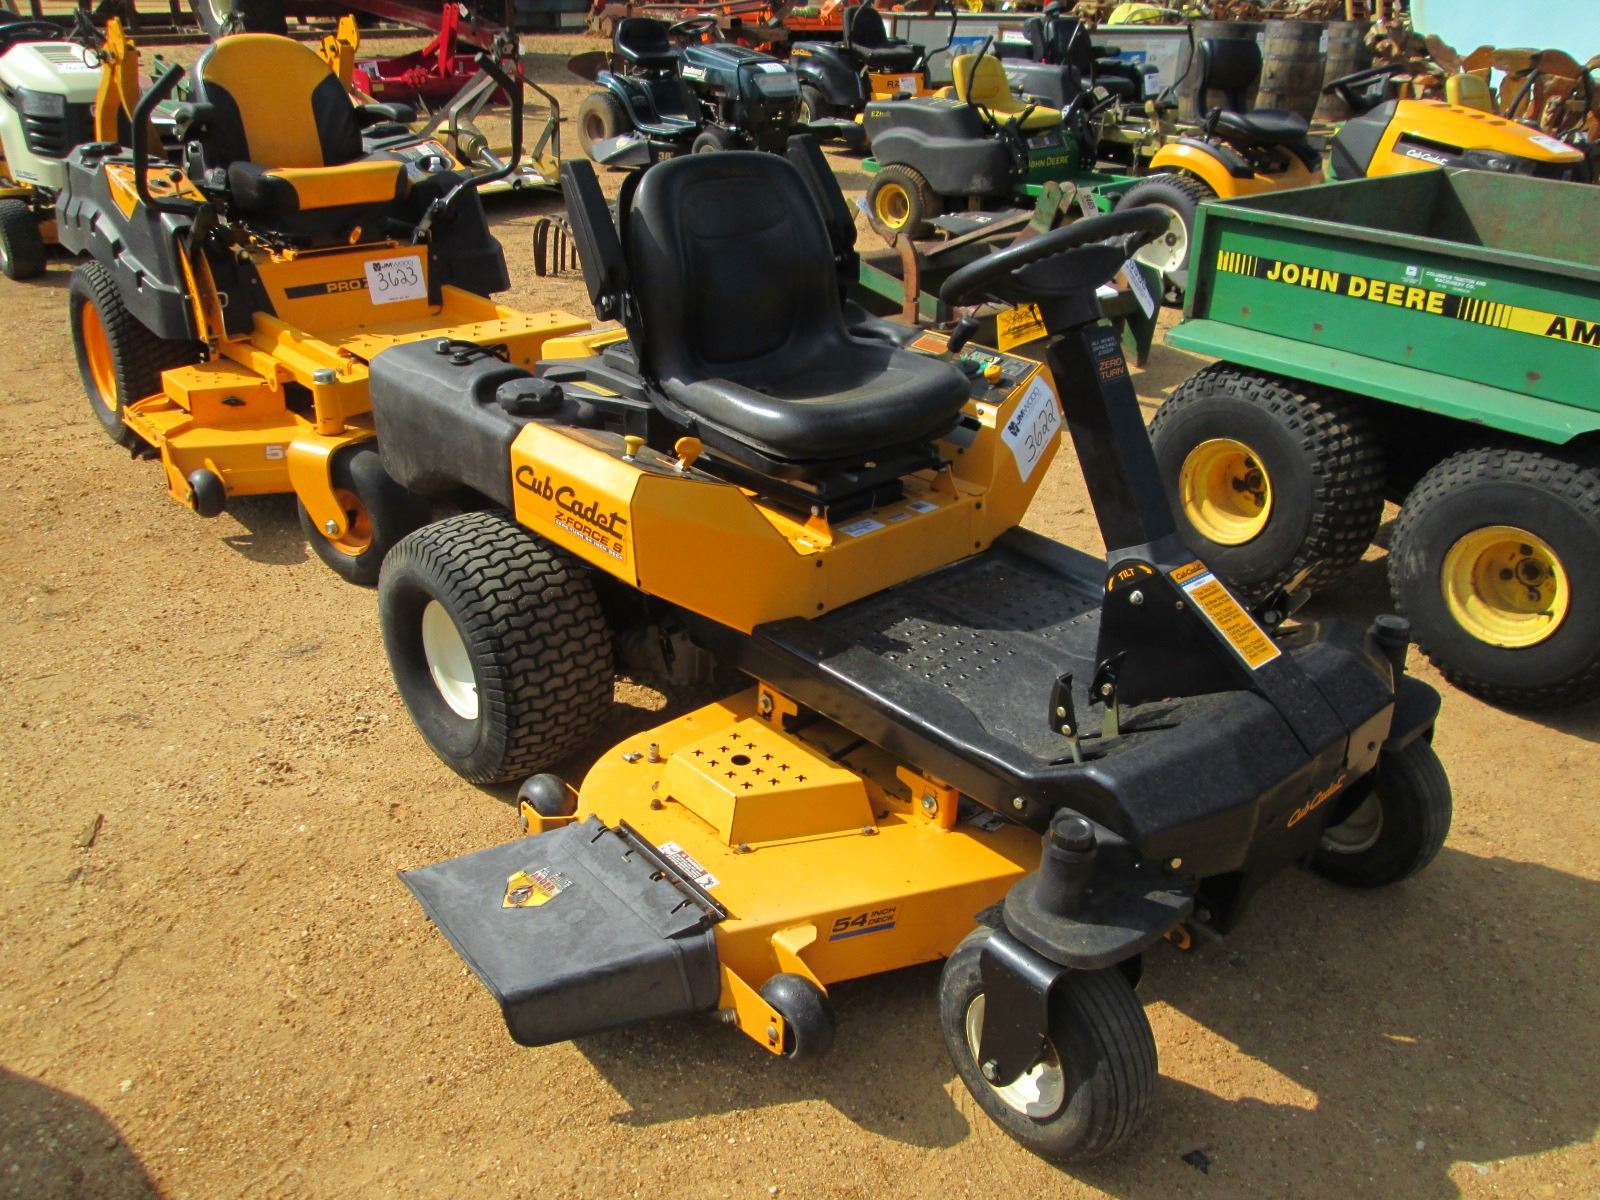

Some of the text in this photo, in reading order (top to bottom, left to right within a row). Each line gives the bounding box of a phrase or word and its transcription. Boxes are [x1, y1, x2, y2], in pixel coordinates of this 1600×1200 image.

[326, 280, 362, 294] PRO
[377, 266, 418, 292] 3623
[1266, 259, 1600, 347] JOHN DEERE AM
[1099, 357, 1122, 370] ZERO
[1101, 366, 1124, 380] TURN
[515, 464, 628, 540] Cub Cadet
[554, 510, 623, 554] Z-FORCE S
[1117, 567, 1136, 581] TILT
[832, 906, 897, 933] 54 INCH
[867, 914, 894, 926] DECK
